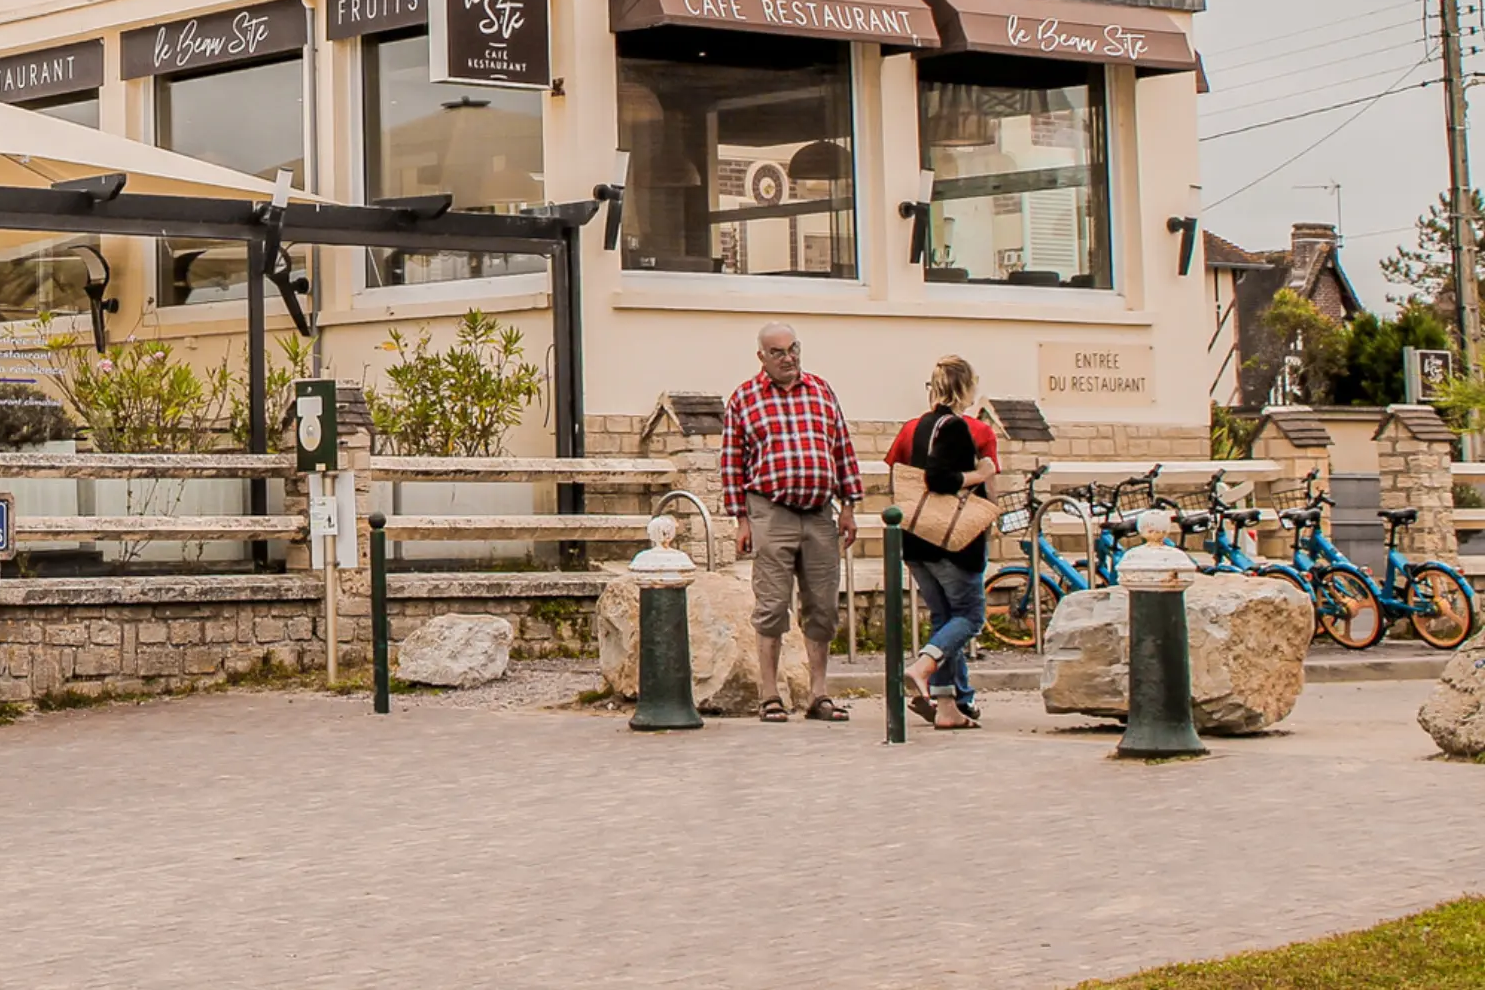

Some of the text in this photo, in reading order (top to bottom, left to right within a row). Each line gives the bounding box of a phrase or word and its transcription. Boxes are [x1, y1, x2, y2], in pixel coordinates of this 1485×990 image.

[153, 11, 270, 68] le Beau Site
[1006, 14, 1149, 60] le Beau Site
[467, 58, 528, 72] RESTAURANT
[1075, 349, 1120, 369] ENTRÉE
[1049, 375, 1146, 392] DU RESTAURANT
